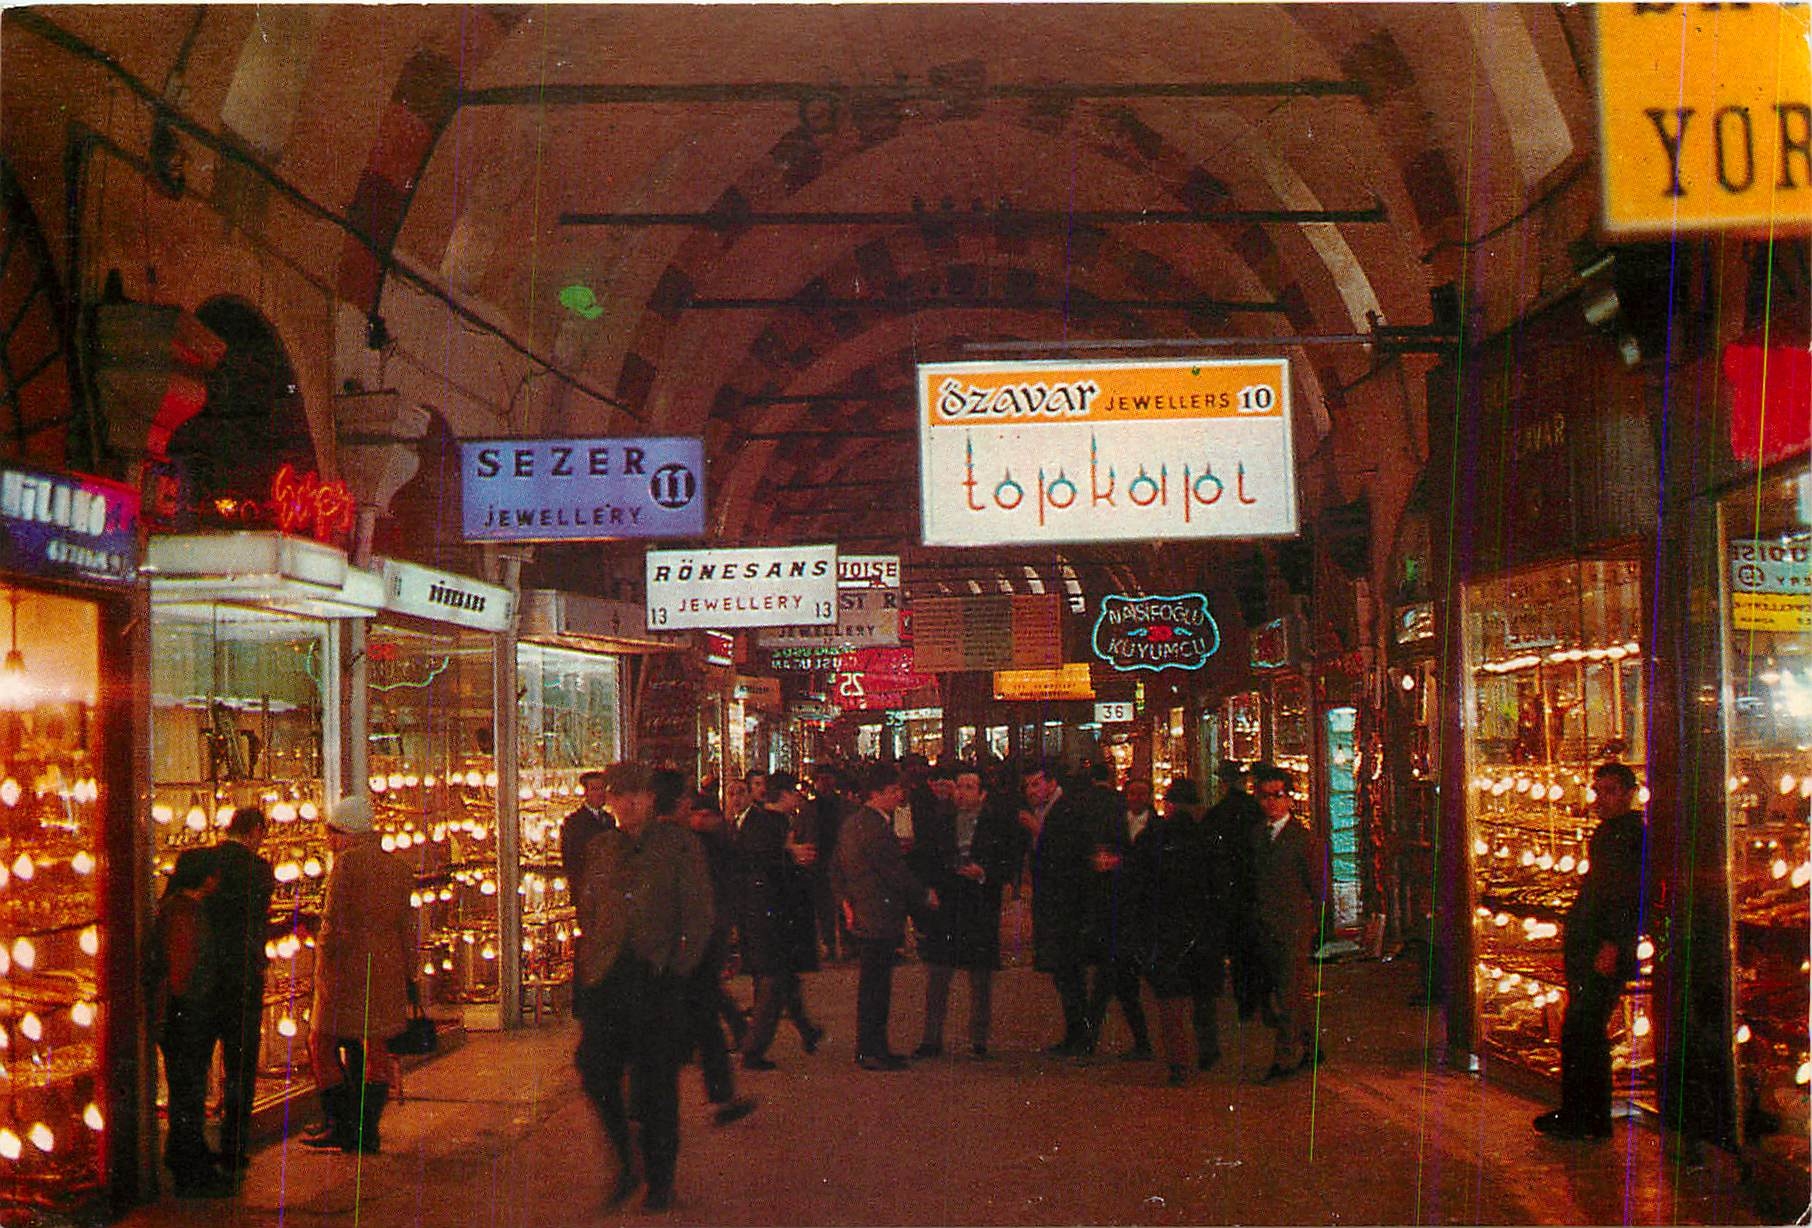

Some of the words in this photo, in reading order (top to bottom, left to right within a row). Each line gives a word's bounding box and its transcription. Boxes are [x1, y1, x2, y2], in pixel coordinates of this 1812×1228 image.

[1100, 392, 1231, 412] JEWELLERS
[1240, 387, 1272, 410] 10
[477, 447, 646, 478] SEZER
[653, 560, 829, 583] RÖNESANS
[651, 607, 668, 625] 13
[815, 601, 833, 619] 13
[678, 595, 804, 612] JEWELLERY
[1102, 704, 1124, 719] 36
